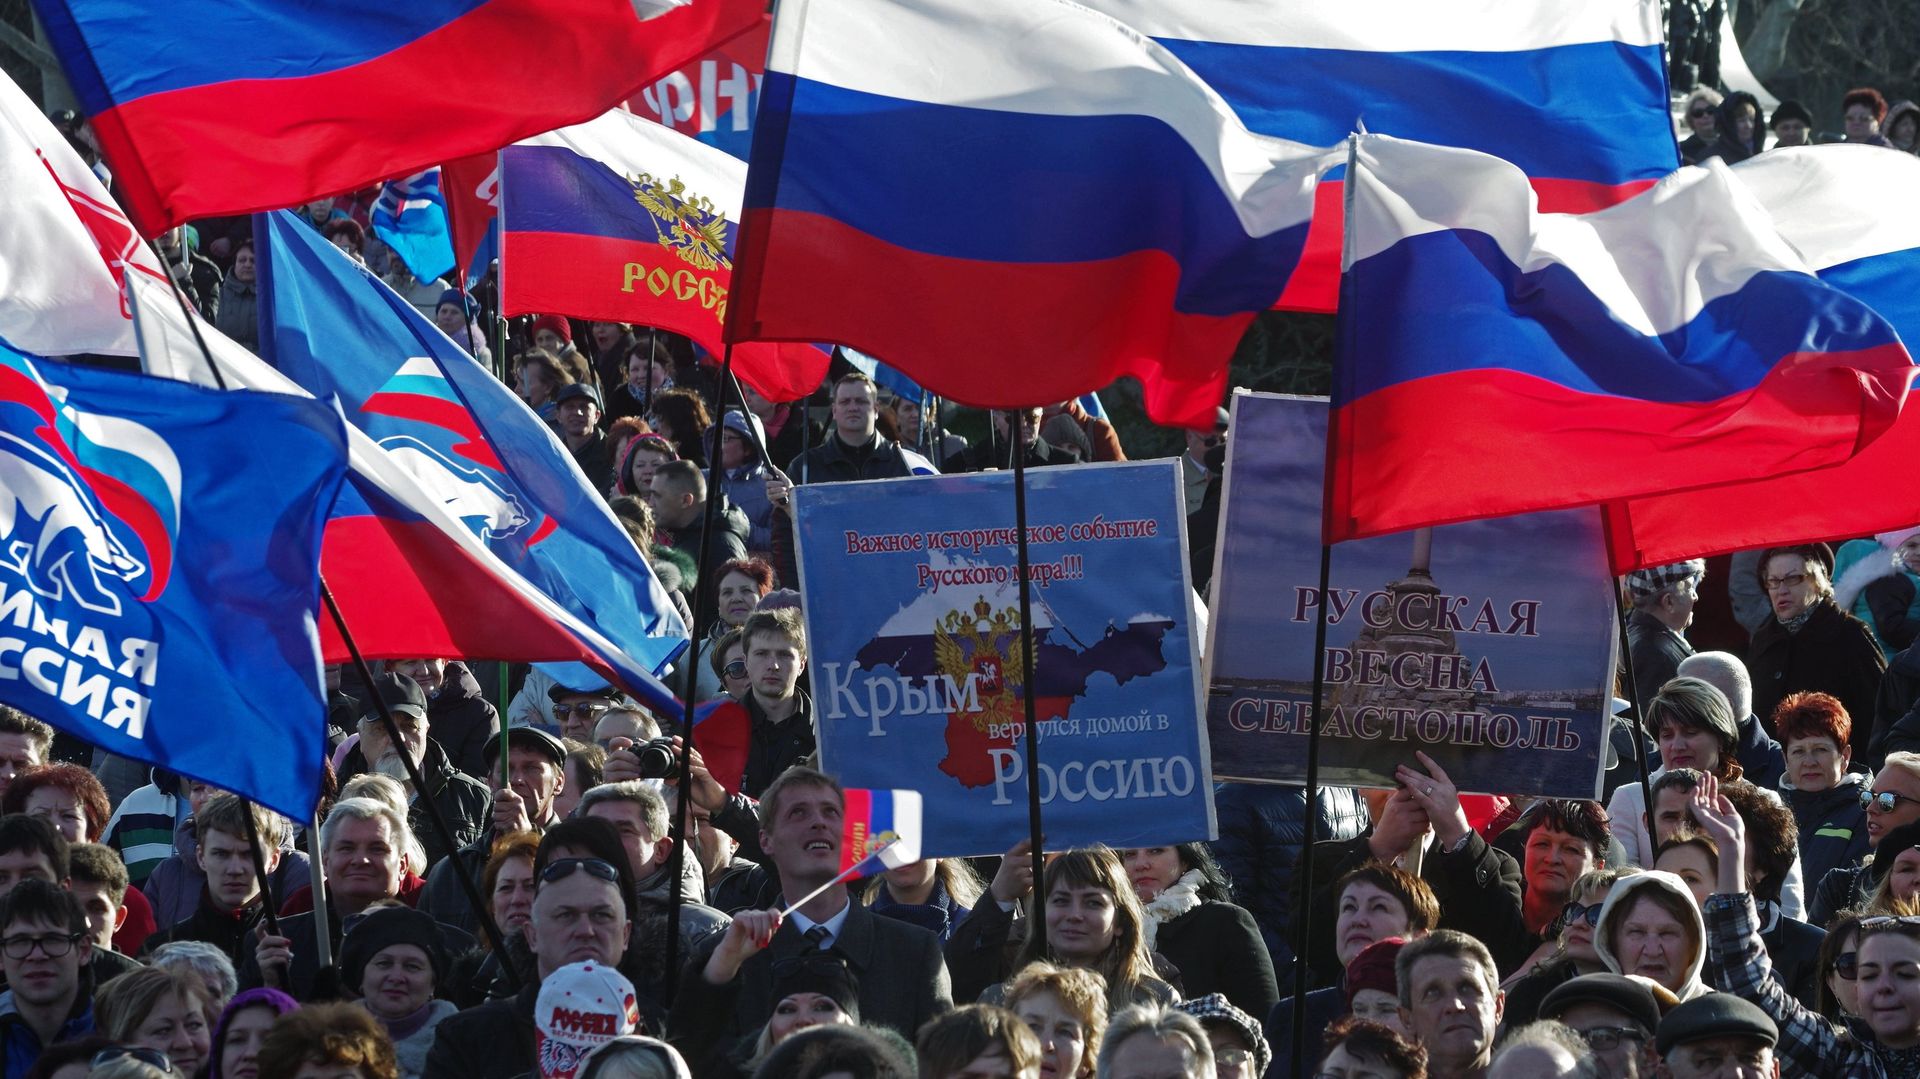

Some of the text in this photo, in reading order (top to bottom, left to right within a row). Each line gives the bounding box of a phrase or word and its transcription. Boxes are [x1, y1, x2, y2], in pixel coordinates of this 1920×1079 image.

[845, 529, 923, 554] Важное
[1069, 513, 1158, 541] событие
[917, 563, 1008, 594] Русского
[1290, 586, 1543, 637] РУССКАЯ
[1323, 647, 1499, 693] ВЕСНА
[822, 660, 983, 736] Крым
[1086, 708, 1151, 738] домой
[1156, 714, 1170, 731] в
[1228, 697, 1581, 751] СЕВАСТОПОЛЬ
[987, 748, 1195, 806] Россию
